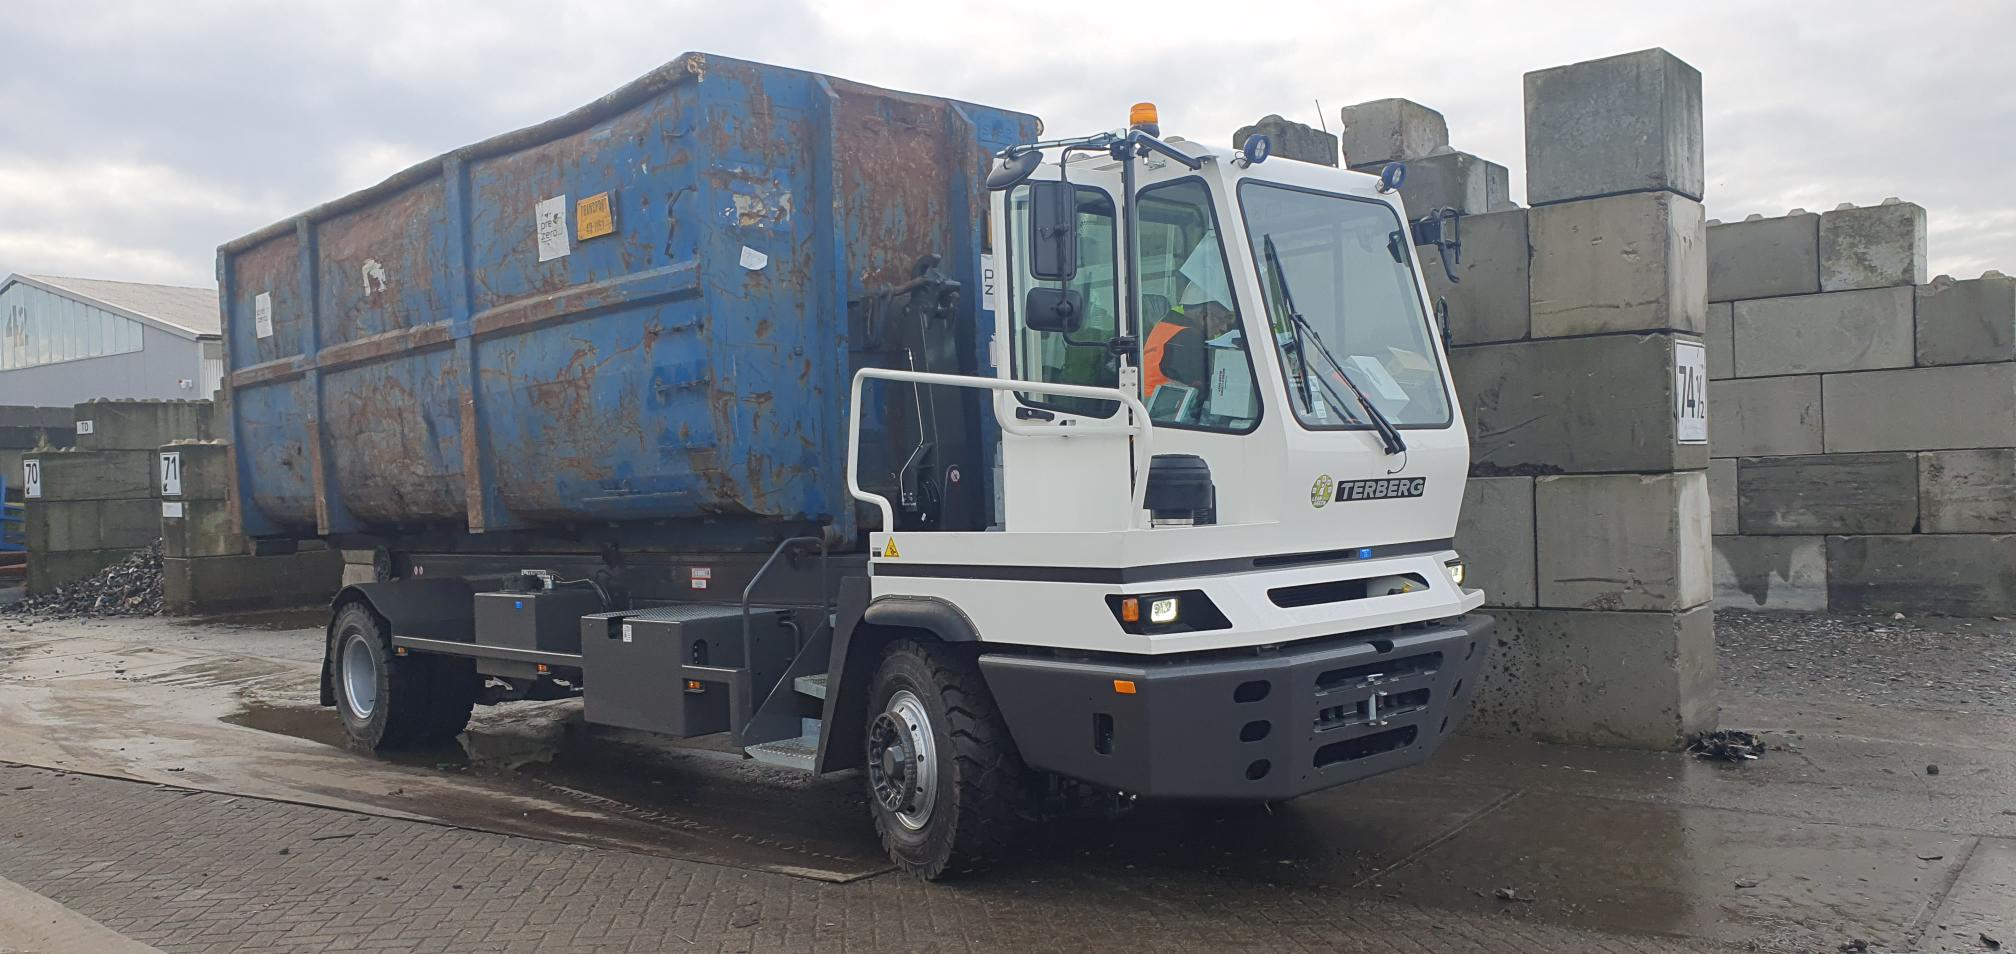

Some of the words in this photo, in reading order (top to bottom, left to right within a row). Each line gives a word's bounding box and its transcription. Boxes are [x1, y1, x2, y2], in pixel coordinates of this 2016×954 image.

[25, 463, 38, 484] 70
[163, 456, 177, 481] 71
[1340, 478, 1424, 500] TERBERG
